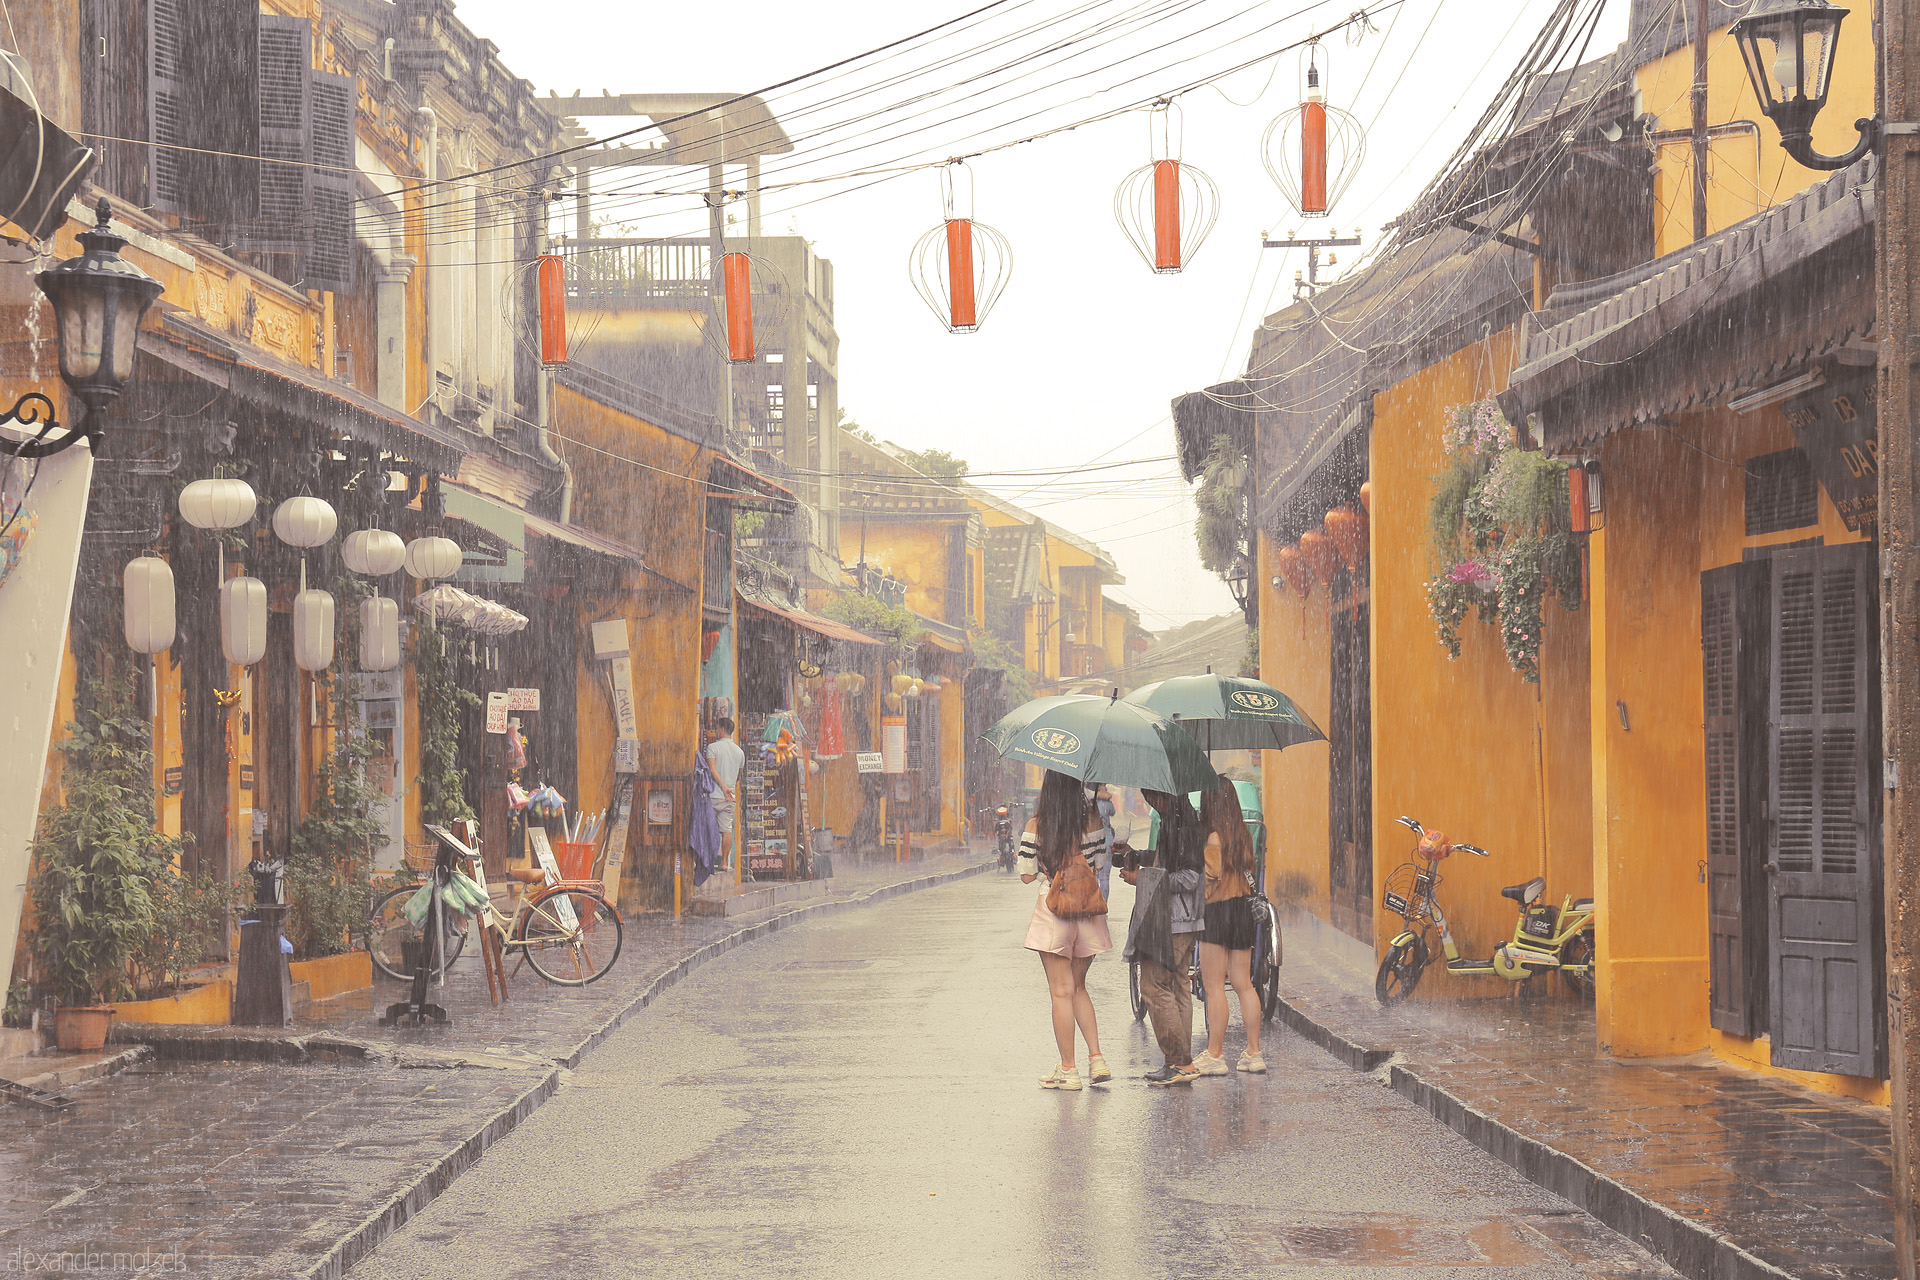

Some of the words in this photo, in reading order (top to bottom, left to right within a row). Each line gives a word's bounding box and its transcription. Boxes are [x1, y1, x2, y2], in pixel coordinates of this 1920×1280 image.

[1840, 443, 1875, 478] DA
[1047, 732, 1065, 749] 5
[858, 754, 881, 762] MONEY
[859, 763, 883, 771] EXCHANGE
[1535, 920, 1551, 929] DK
